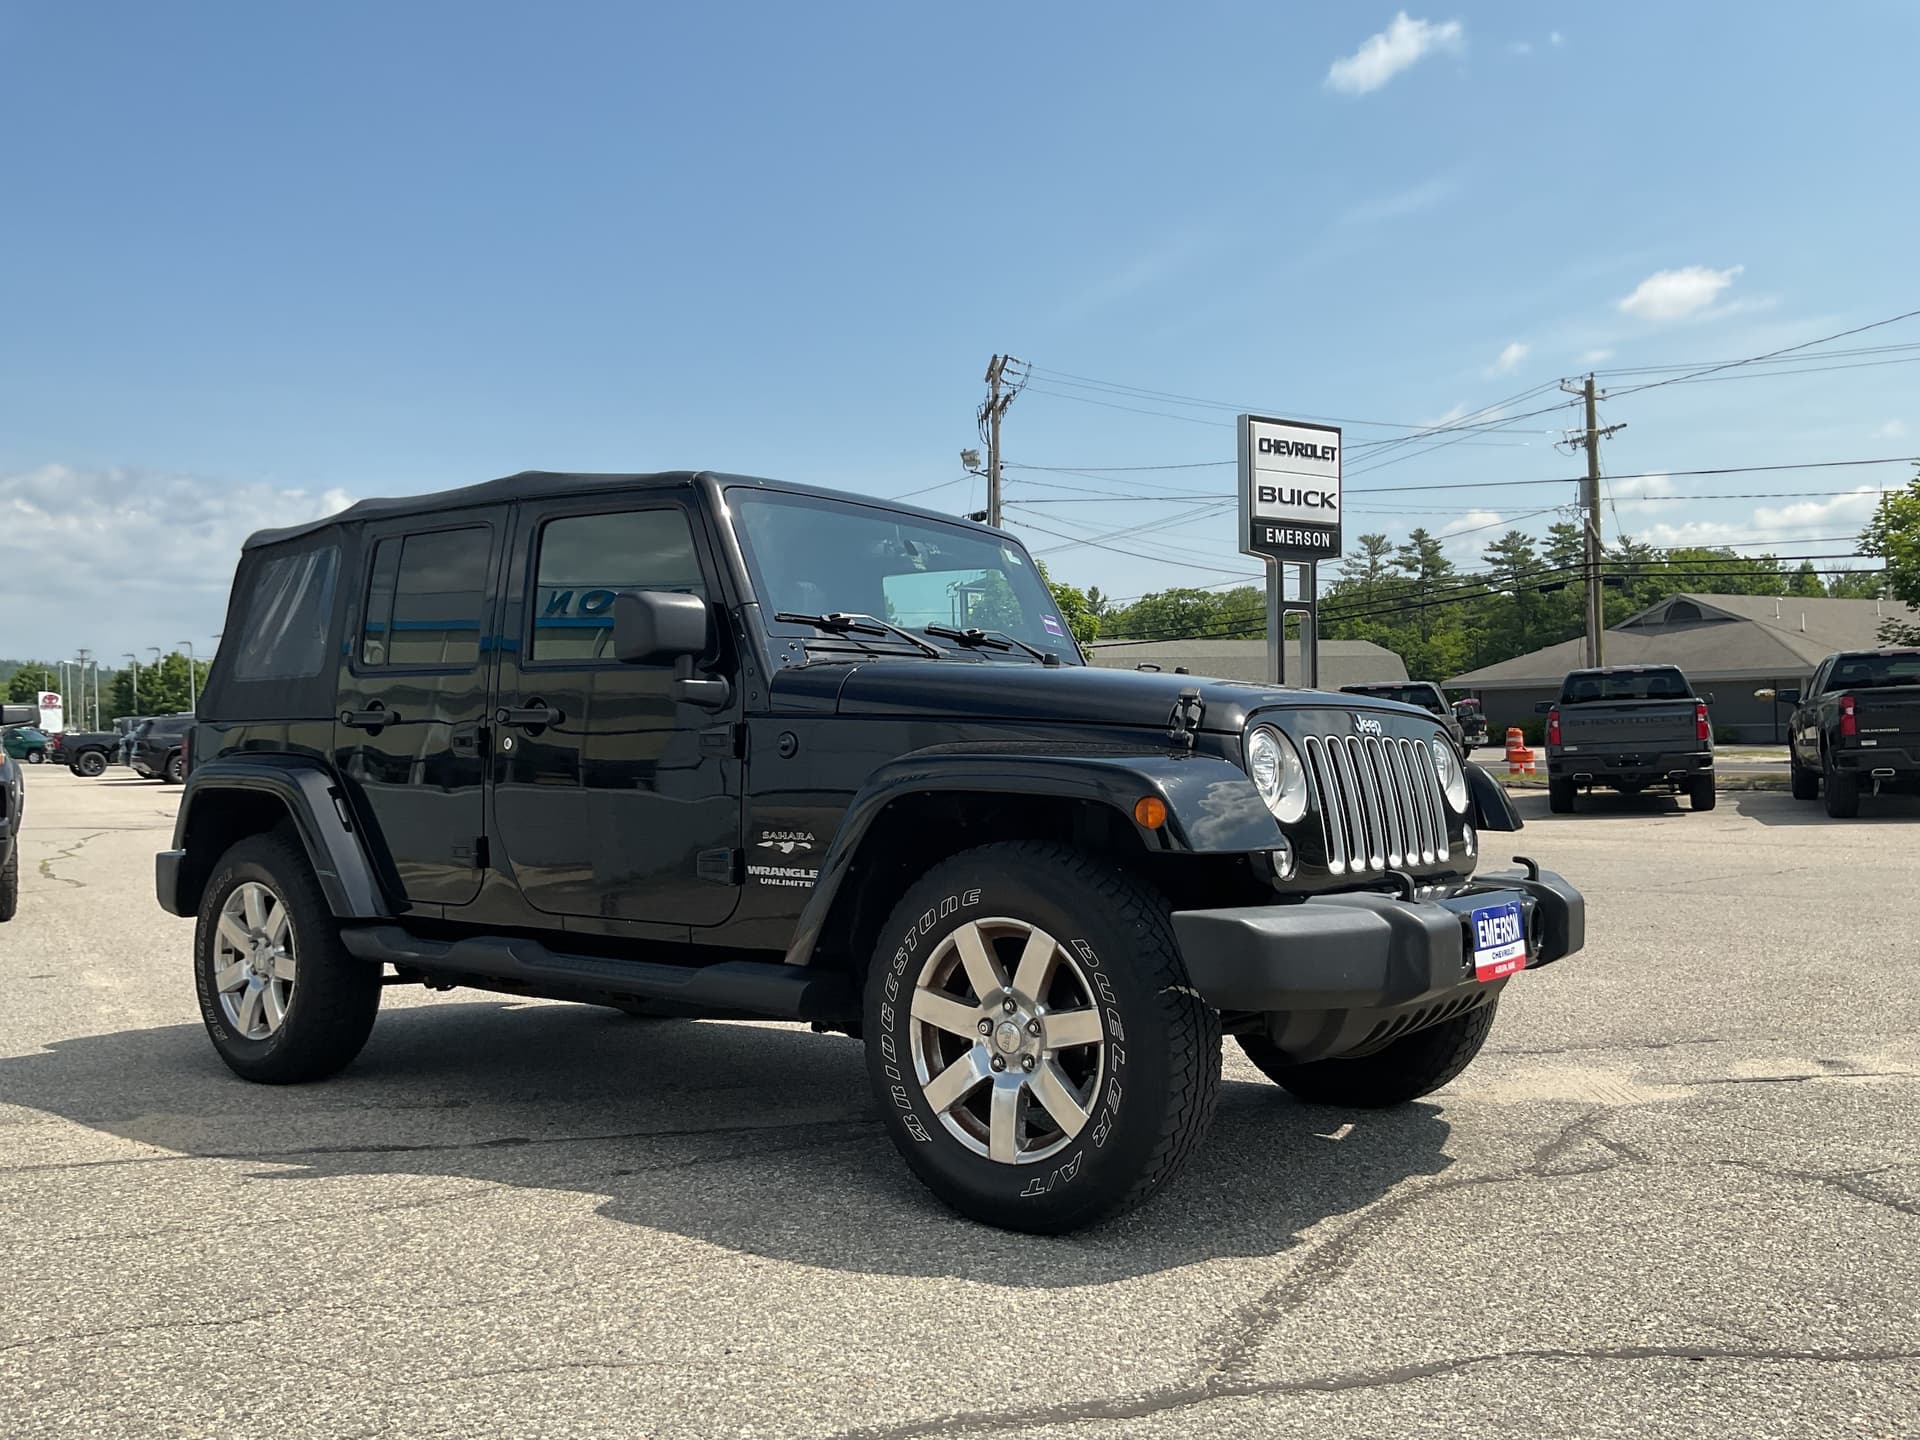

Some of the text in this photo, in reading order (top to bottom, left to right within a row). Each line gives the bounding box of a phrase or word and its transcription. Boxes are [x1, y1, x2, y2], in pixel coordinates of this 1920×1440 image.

[1258, 437, 1337, 462] CHEVROLET
[1258, 485, 1337, 509] BUICK
[1266, 528, 1330, 547] EMERSON
[1355, 714, 1382, 736] Jeep
[762, 831, 815, 840] SAHARA
[747, 865, 819, 878] WRANGLE
[760, 877, 815, 887] UNLIMITE
[1477, 912, 1520, 948] EMERSON
[881, 888, 981, 1142] BRIDGESTONE
[1020, 939, 1125, 1197] DUELER A/T
